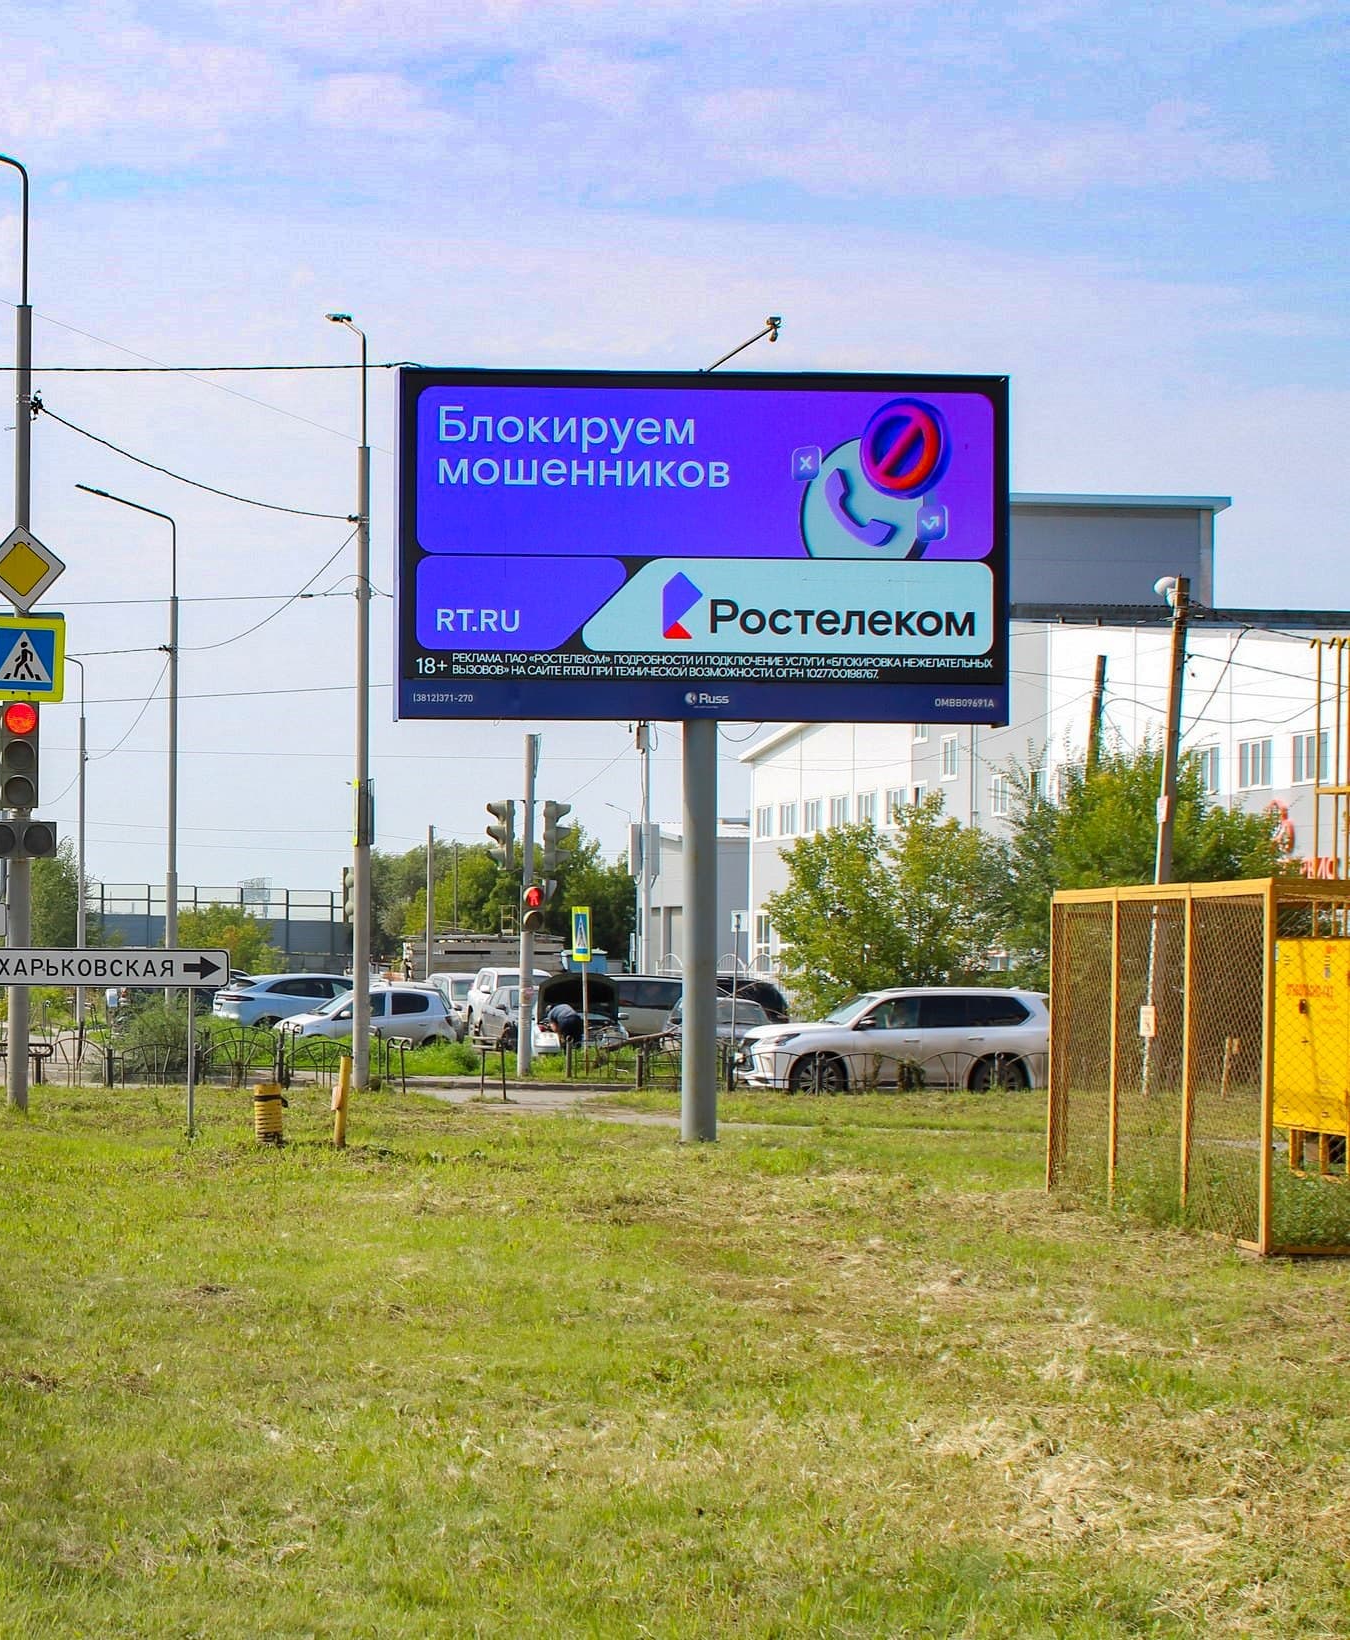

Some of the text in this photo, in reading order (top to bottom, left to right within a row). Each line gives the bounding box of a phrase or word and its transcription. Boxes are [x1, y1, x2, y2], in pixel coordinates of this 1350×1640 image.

[438, 405, 695, 454] Блокируем
[438, 457, 731, 488] мошенников
[435, 608, 520, 633] RT.RU
[709, 598, 976, 638] Ростелеком
[415, 657, 448, 674] 18+
[452, 653, 993, 668] РЕКЛАМА. ПАО «РОСТЕЛЕКОМ». ПОДРОБНОСТИ И ПОДКЛЮЧЕНИЕ УСЛУГИ «БЛОКИРОВКА НЕЖЕЛАТЕЛЬНЫХ
[452, 665, 510, 675] ВЫЗОВОВ»
[512, 665, 527, 675] НА
[527, 664, 562, 676] САЙТЕ
[591, 666, 613, 676] ПРИ
[615, 666, 687, 677] ТЕХНИЧЕСКОЙ
[690, 667, 774, 678] ВОЗМОЖНОСТИ.
[776, 668, 804, 678] ОГРН
[413, 693, 474, 703] (3812)371-270
[699, 693, 730, 704] Russ
